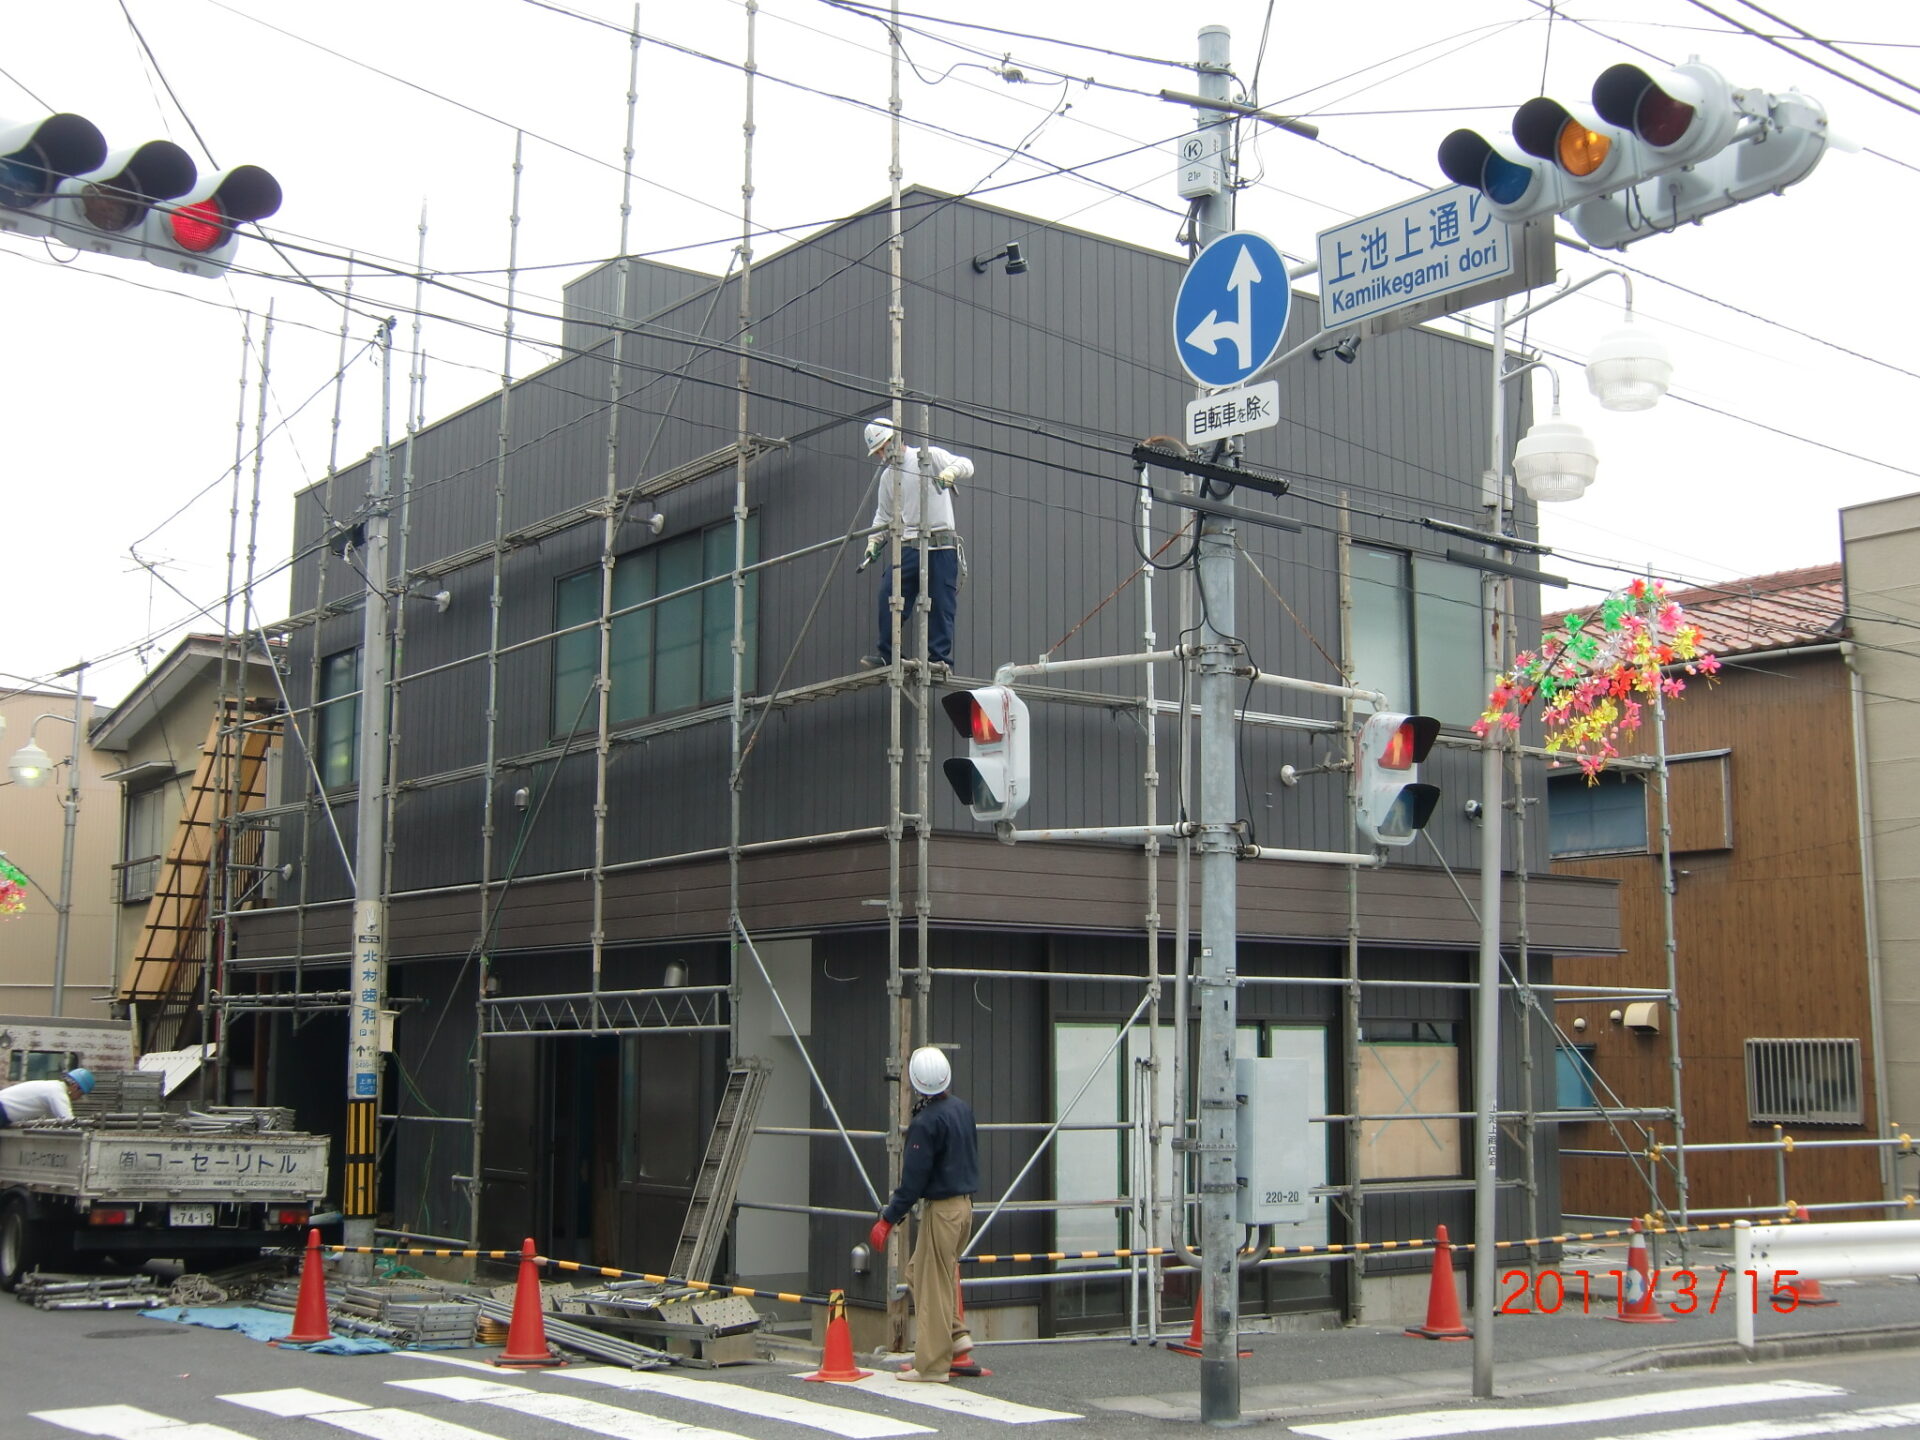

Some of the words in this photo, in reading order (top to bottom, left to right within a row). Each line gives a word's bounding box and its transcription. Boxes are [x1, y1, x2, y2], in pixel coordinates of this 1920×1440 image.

[1328, 193, 1492, 286] 上池上通り
[1332, 255, 1449, 314] Kamiikegami
[1458, 239, 1498, 272] dori
[1194, 395, 1271, 435] 自転車を除く
[362, 949, 378, 1025] 北村歯科
[1265, 1191, 1299, 1204] 220-20
